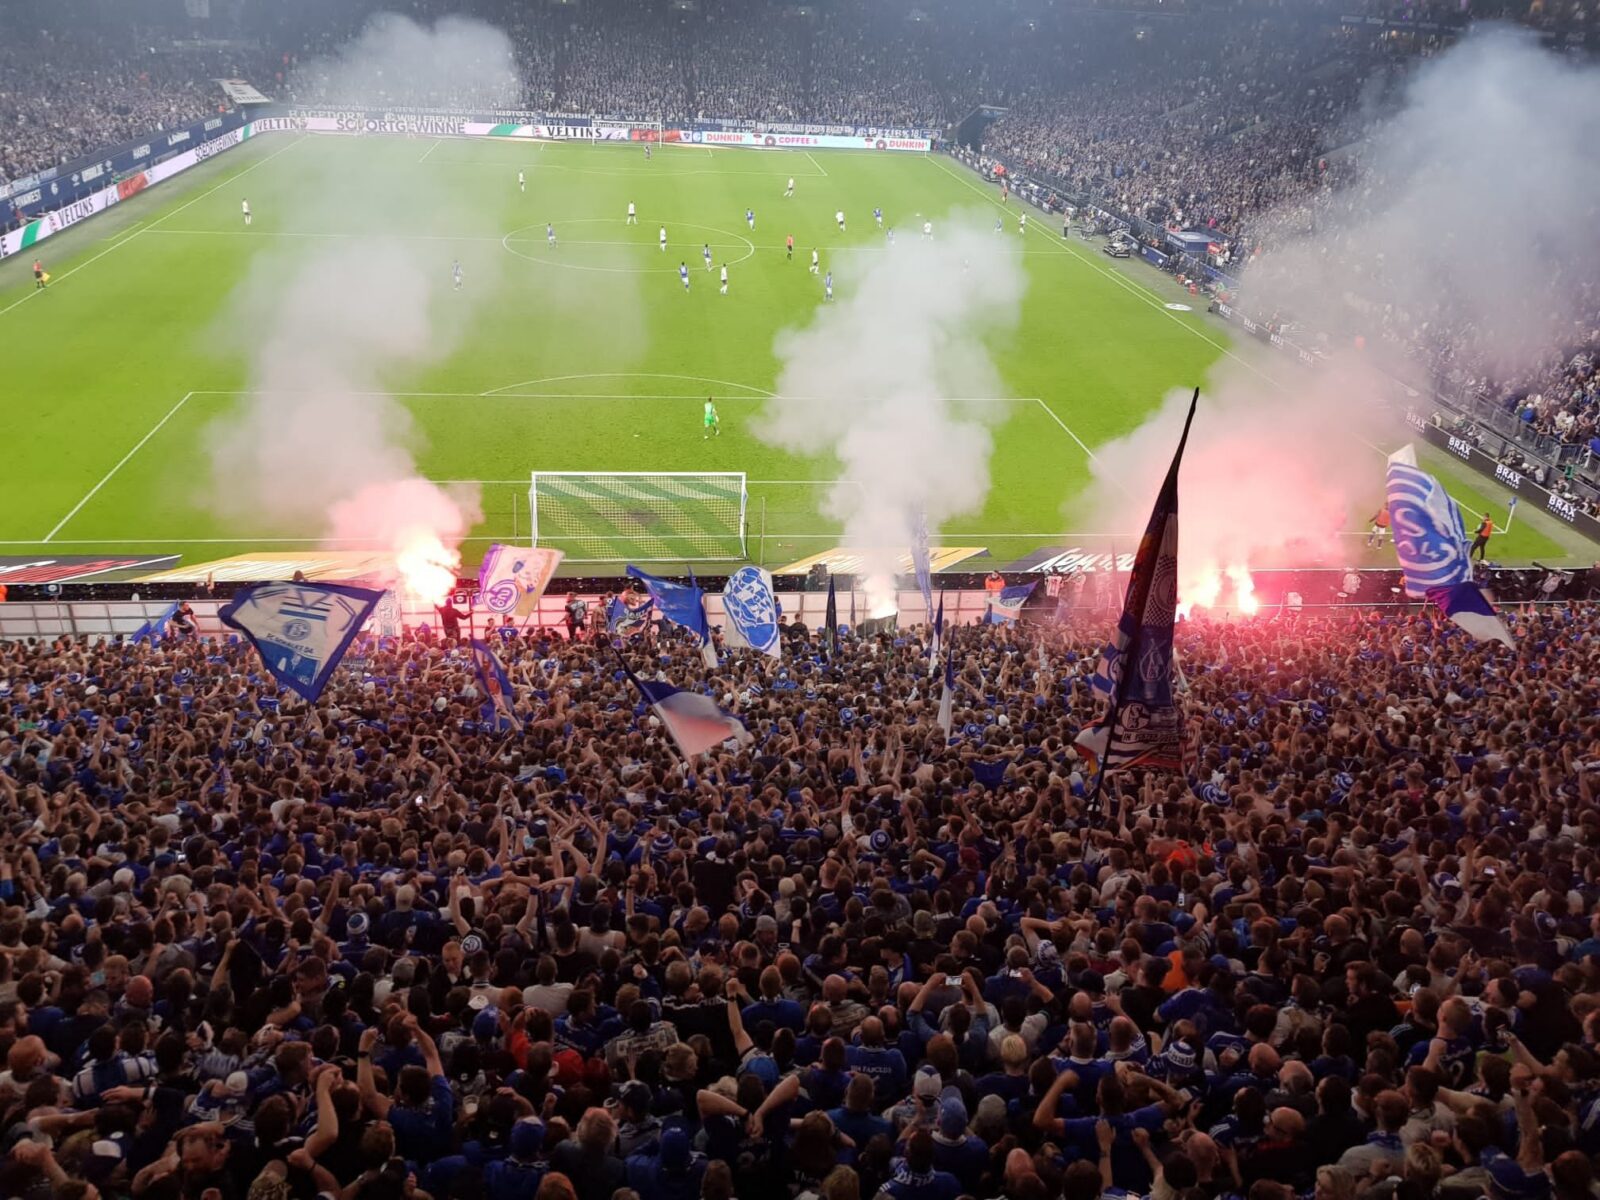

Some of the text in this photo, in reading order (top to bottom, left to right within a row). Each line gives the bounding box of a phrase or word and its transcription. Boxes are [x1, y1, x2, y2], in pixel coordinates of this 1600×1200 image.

[256, 118, 308, 131] VELTINS
[547, 126, 602, 138] VELTINS
[778, 136, 810, 145] COFFEE
[58, 197, 95, 226] VELTINS
[1405, 411, 1426, 430] BRAX
[1448, 436, 1472, 456] BRAX
[1496, 463, 1522, 485] BRAX
[1548, 493, 1578, 518] BRAX
